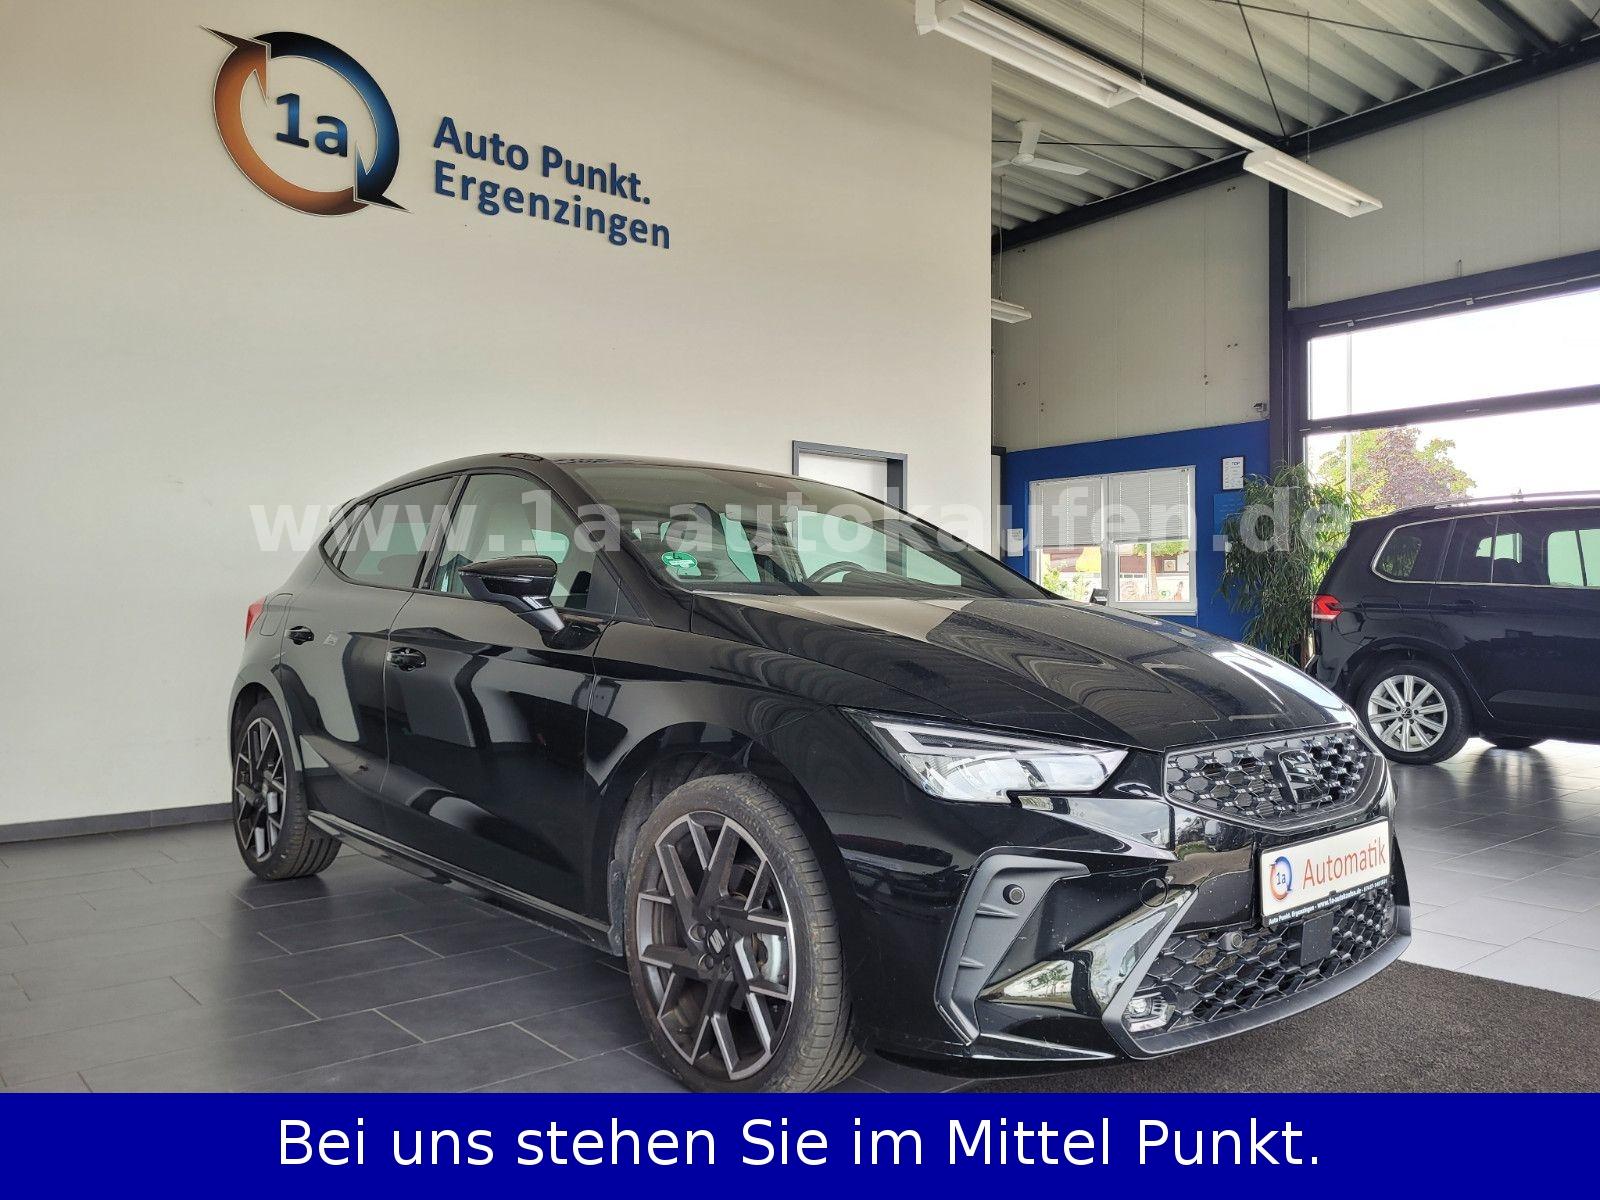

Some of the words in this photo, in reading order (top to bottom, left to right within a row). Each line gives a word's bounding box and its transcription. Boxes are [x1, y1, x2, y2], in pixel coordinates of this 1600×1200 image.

[275, 92, 349, 158] 1a
[433, 115, 530, 171] Auto
[541, 144, 652, 205] Punkt.
[433, 160, 671, 250] Ergenzingen
[1276, 872, 1287, 886] 1a
[1302, 837, 1386, 890] Automatik
